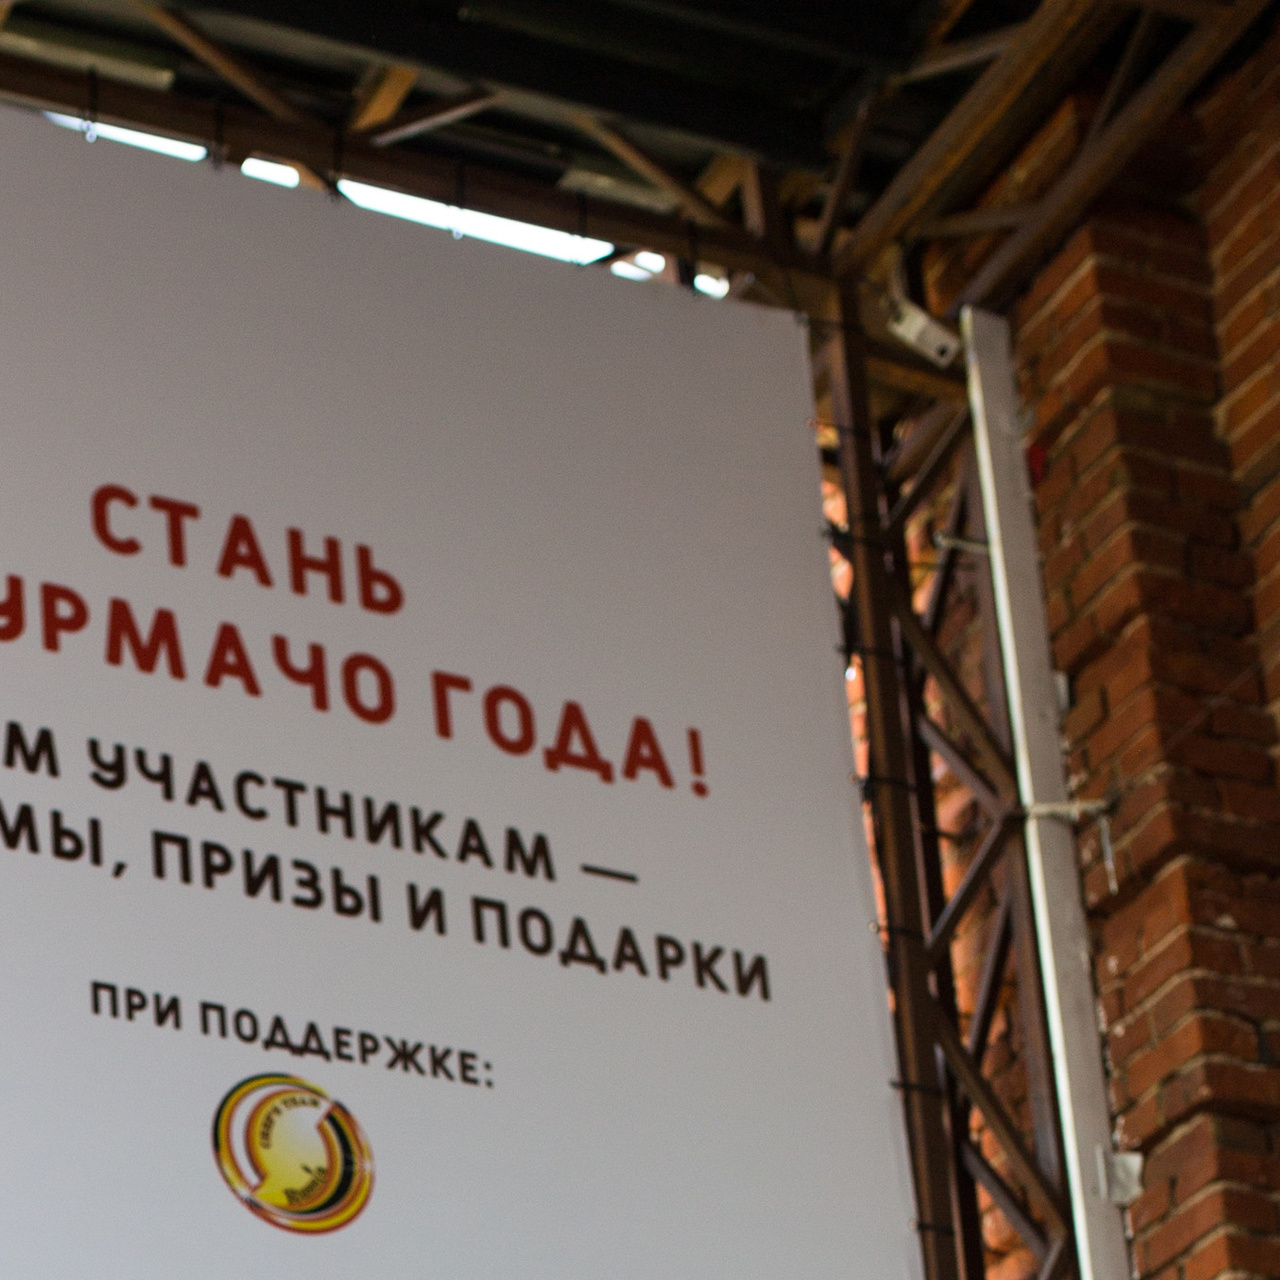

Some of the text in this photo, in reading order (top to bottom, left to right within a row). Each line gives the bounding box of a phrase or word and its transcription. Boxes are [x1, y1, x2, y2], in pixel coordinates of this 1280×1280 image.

[91, 483, 405, 616] СТАНЬ
[431, 670, 709, 798] ГОДА!
[87, 738, 556, 882] УЧАСТНИКАМ
[151, 830, 382, 924] ПРИЗЫ
[406, 882, 447, 936] И
[470, 895, 771, 1002] ПОДАРКИ
[90, 980, 493, 1088] ПРИ ПОДДЕРЖКЕ:
